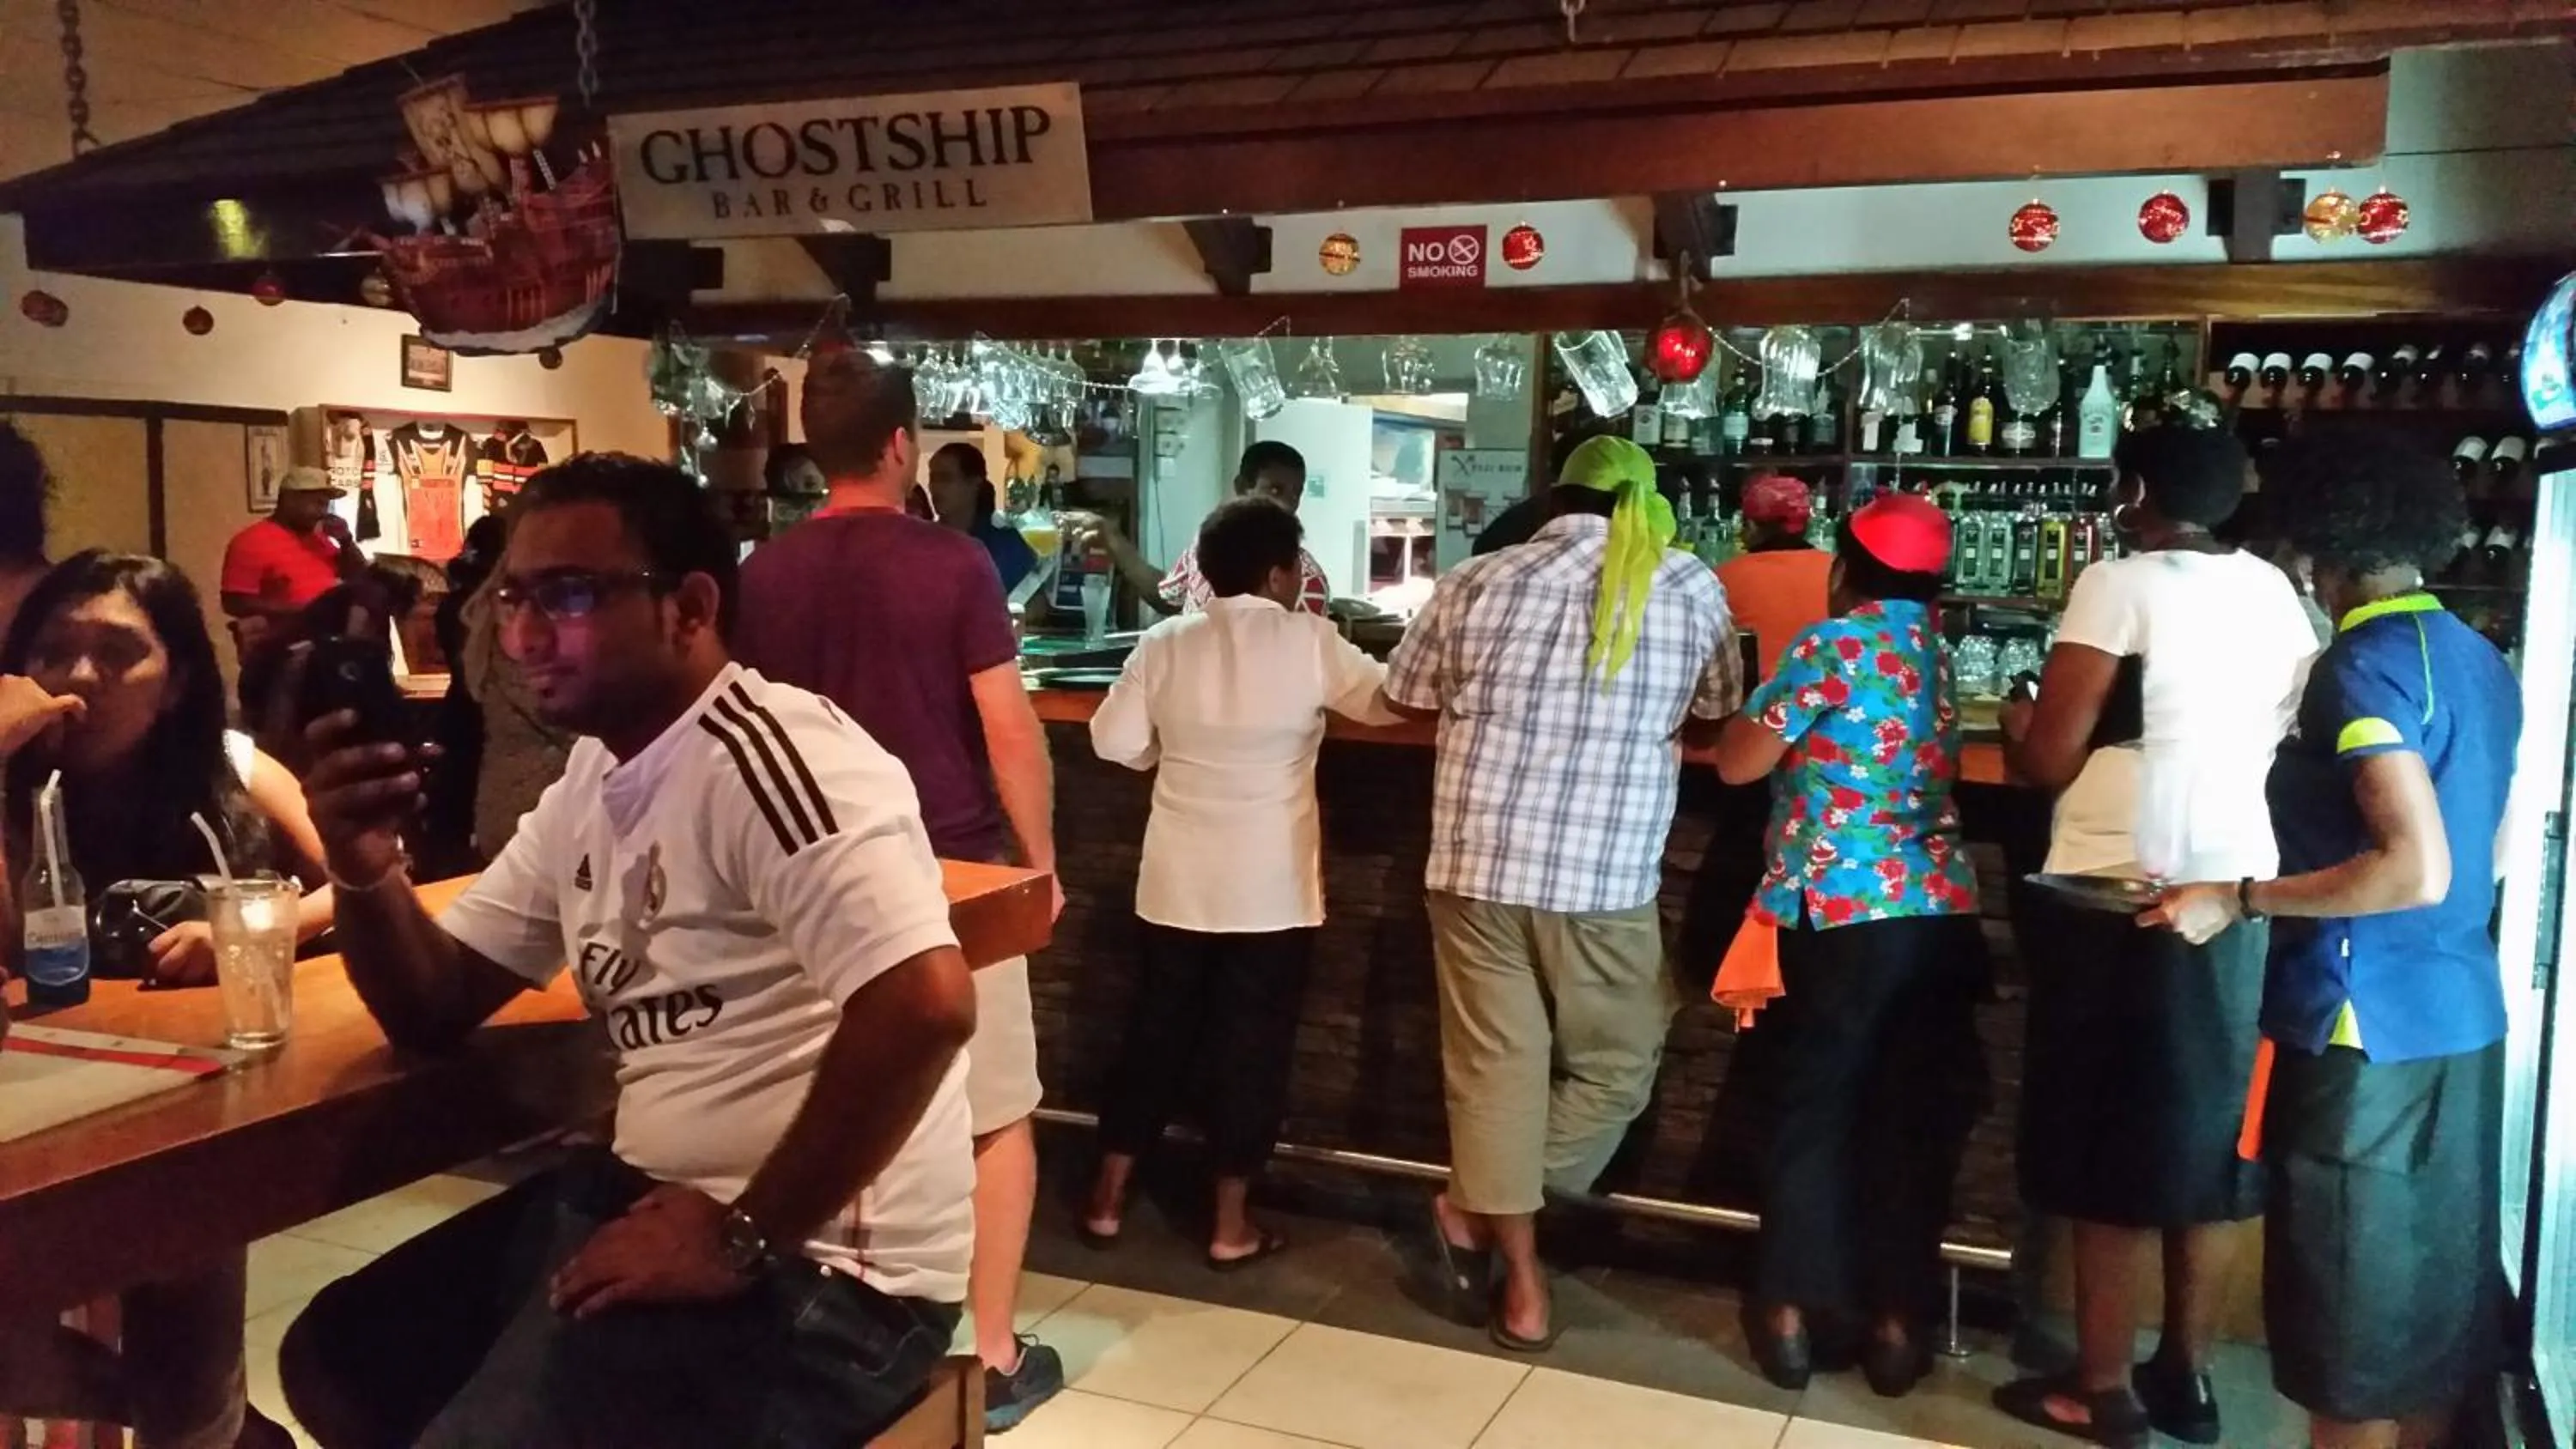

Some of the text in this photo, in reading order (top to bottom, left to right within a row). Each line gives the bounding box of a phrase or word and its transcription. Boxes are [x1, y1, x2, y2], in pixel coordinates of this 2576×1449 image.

[640, 106, 1051, 185] GHOSTSHIP
[713, 179, 987, 219] BAR & GRILL
[1407, 264, 1479, 278] SMOKING
[1408, 241, 1444, 262] NO
[580, 942, 641, 996] Fly
[605, 984, 723, 1050] ates
